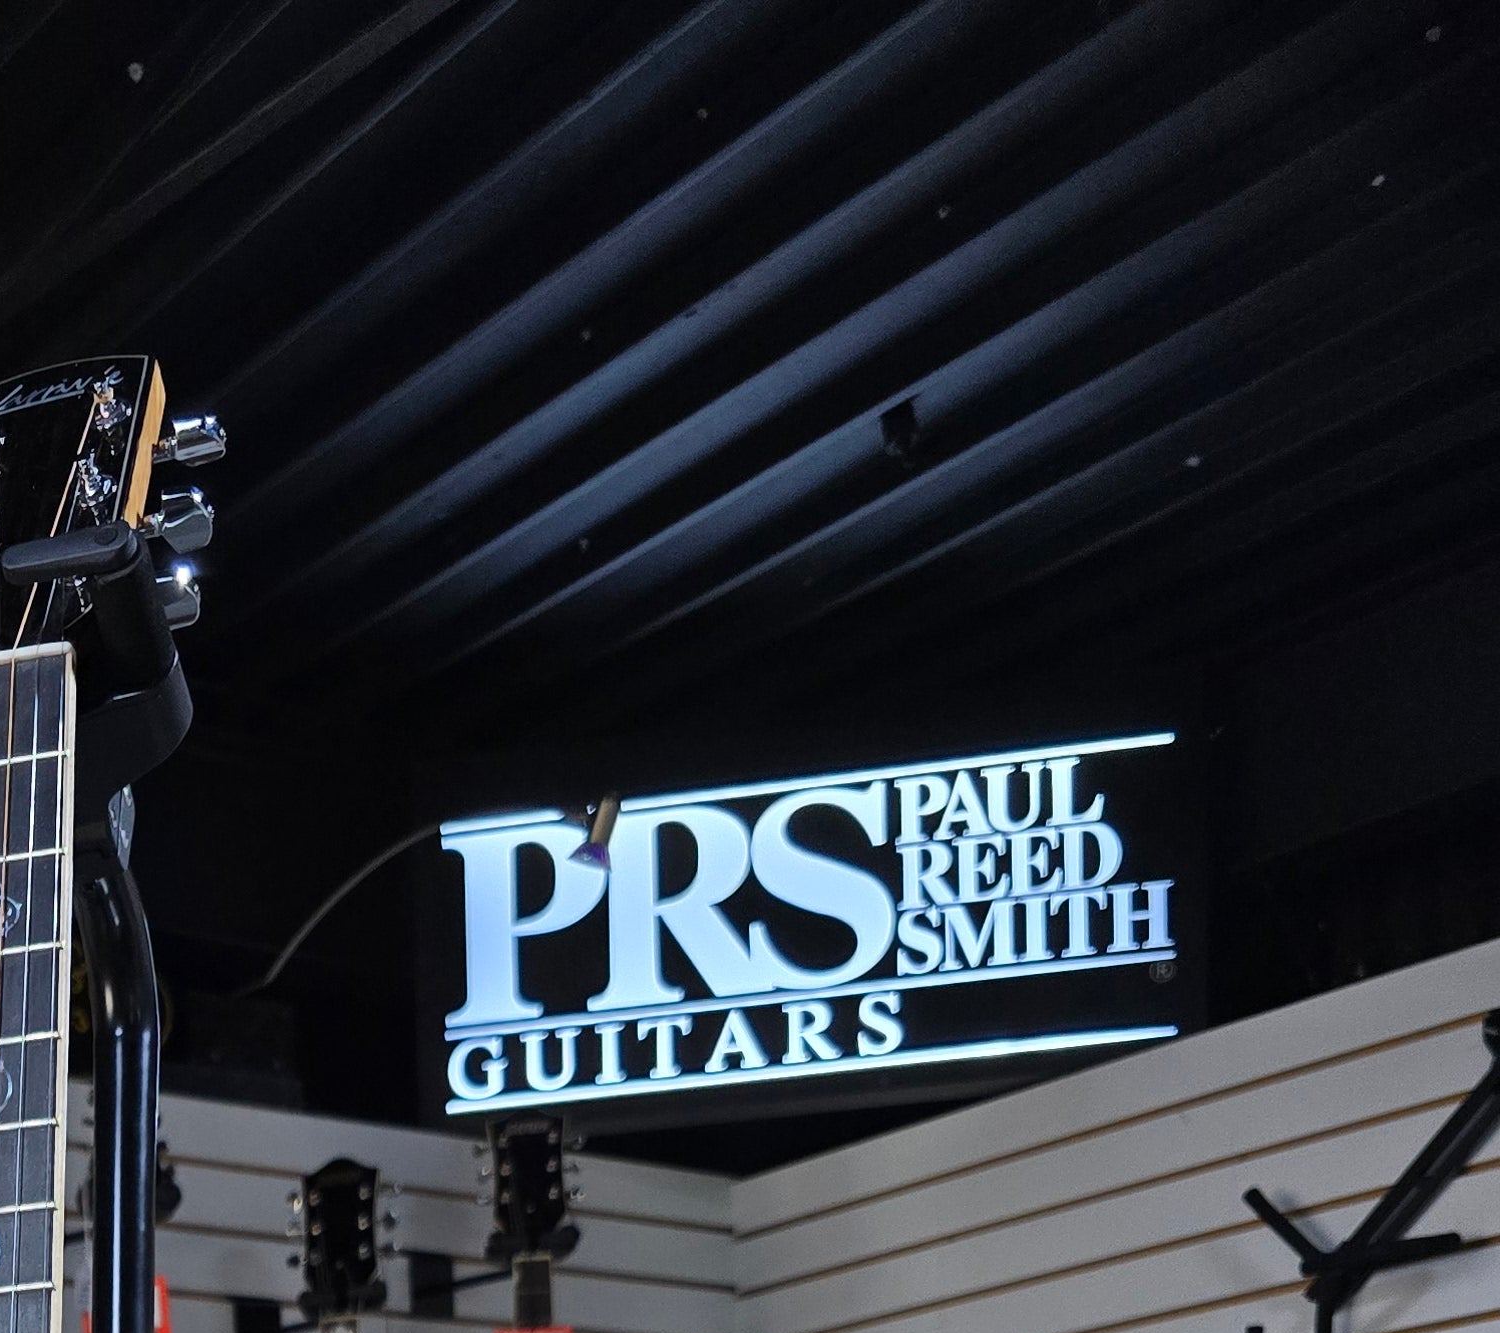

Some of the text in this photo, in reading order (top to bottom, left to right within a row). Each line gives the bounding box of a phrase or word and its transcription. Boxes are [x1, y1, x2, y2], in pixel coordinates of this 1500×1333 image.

[895, 757, 1105, 847] PAUL
[440, 780, 900, 1029] PRS
[896, 822, 1123, 912] REED
[898, 880, 1176, 976] SMITH
[447, 991, 902, 1100] GUITARS
